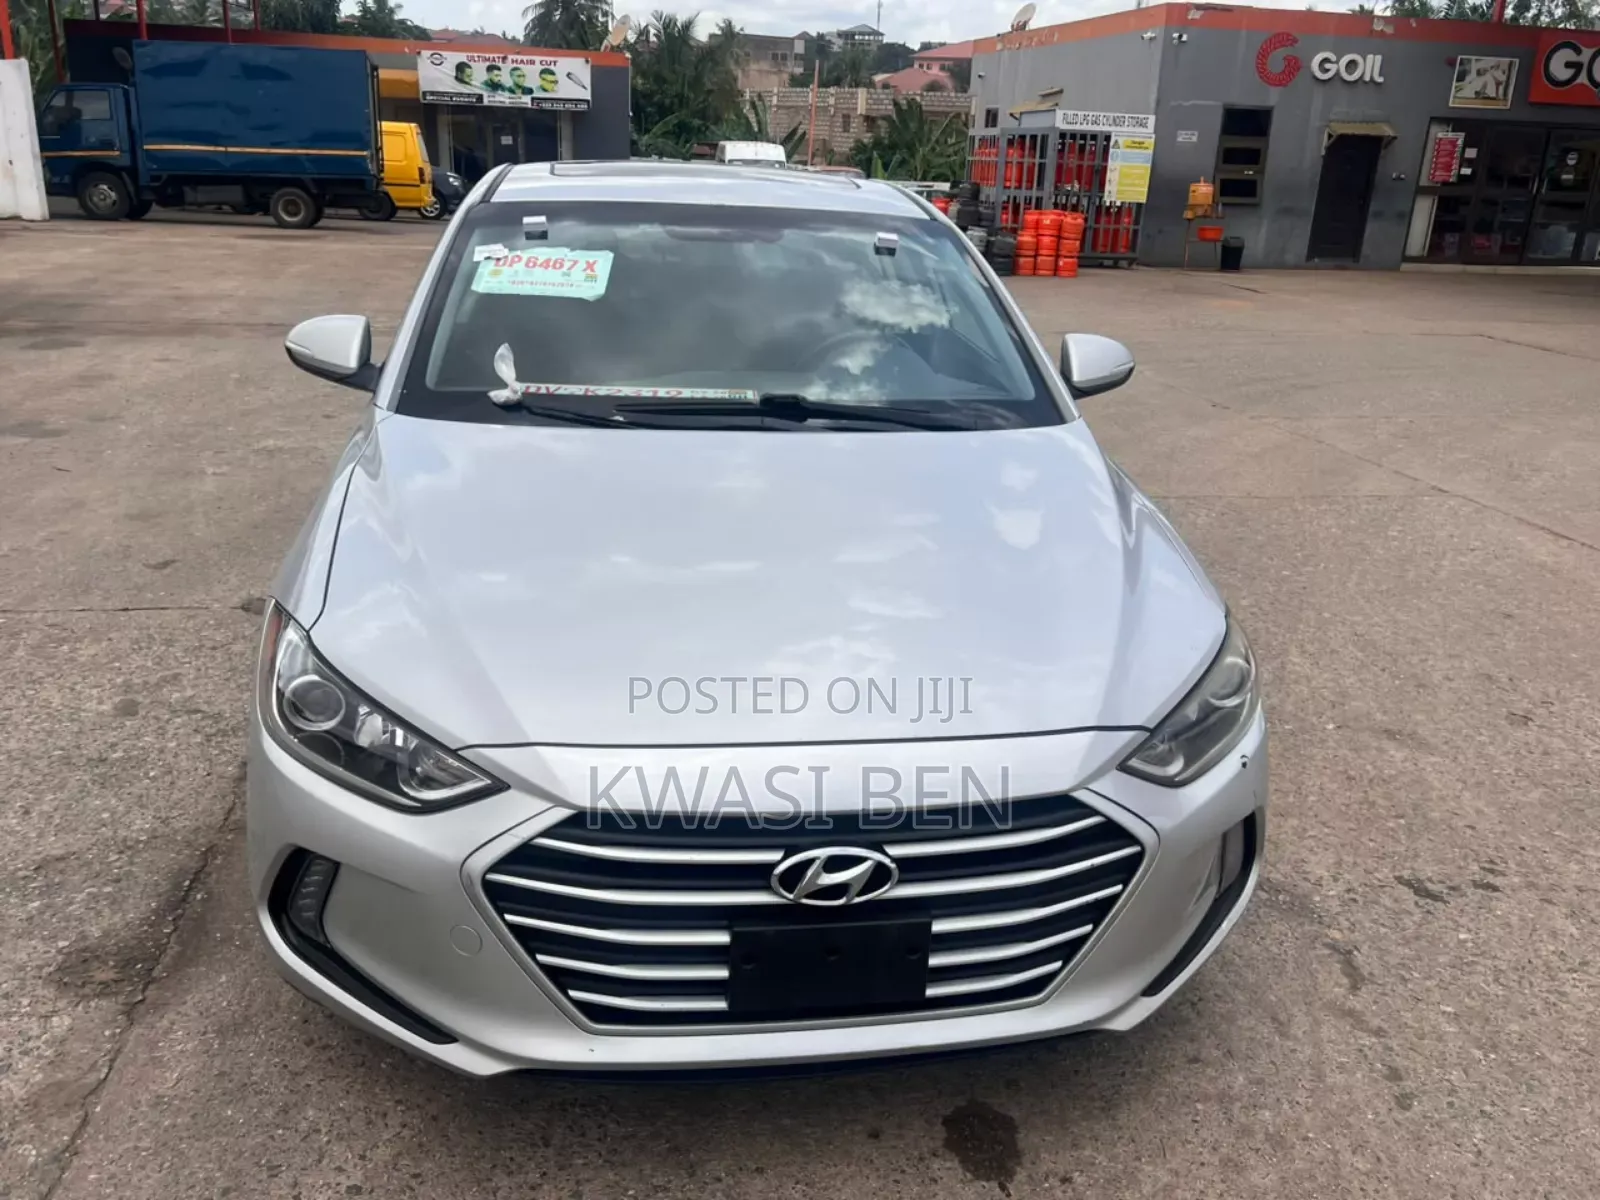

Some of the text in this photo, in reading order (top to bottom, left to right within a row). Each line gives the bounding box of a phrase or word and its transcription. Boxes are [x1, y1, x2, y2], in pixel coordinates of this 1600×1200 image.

[466, 54, 508, 64] ULTIMATE
[1310, 51, 1384, 84] GOIL
[1062, 112, 1150, 129] FILLED LPG GAS CYLINDER STORAGE
[524, 256, 579, 271] 6467
[582, 259, 598, 273] X
